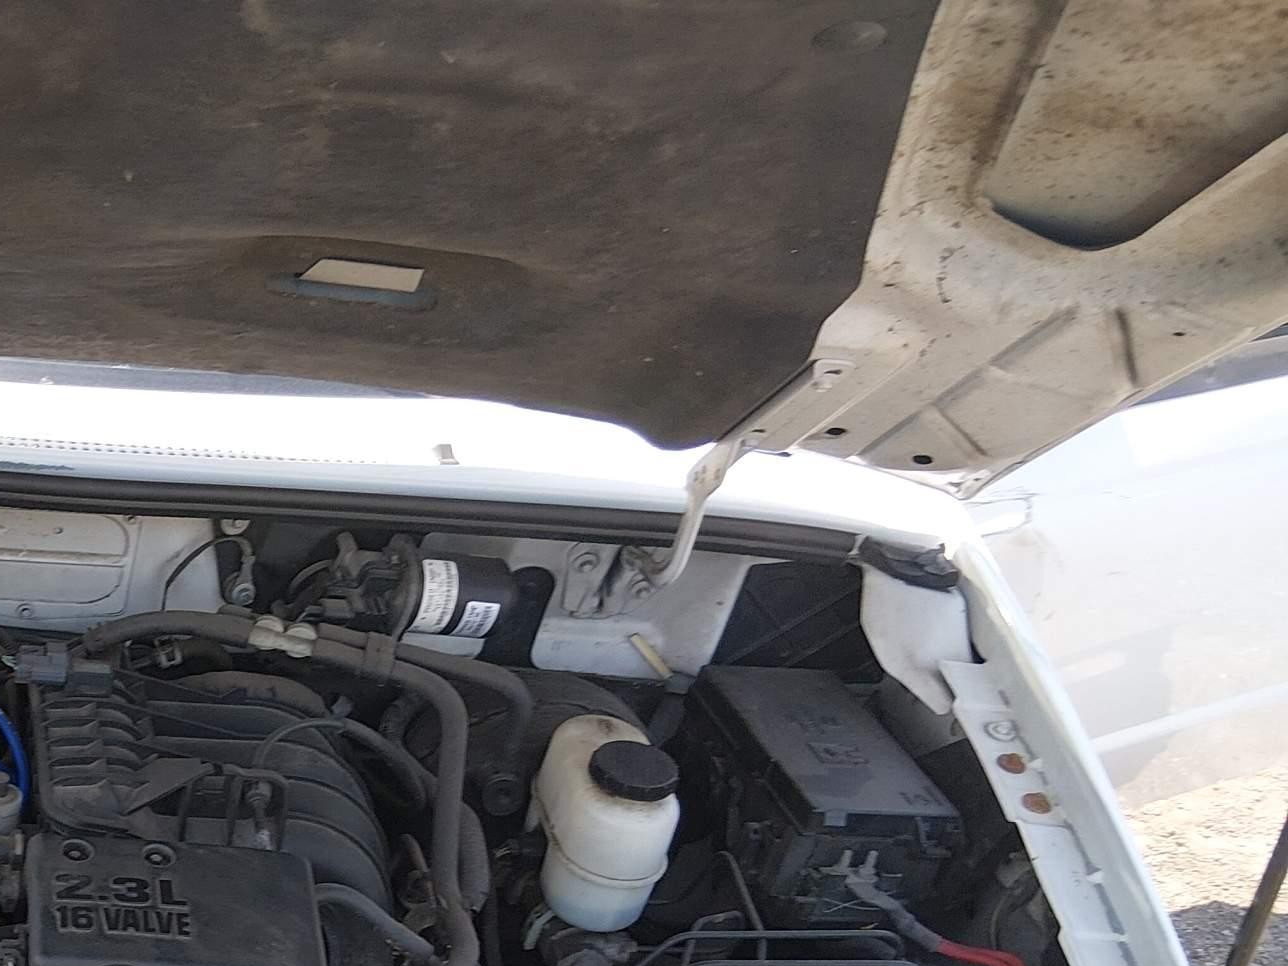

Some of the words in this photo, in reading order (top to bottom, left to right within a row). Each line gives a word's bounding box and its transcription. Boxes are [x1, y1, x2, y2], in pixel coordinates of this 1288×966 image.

[55, 873, 188, 906] 2.3L
[56, 906, 94, 931] 16
[103, 908, 192, 938] VALVE
